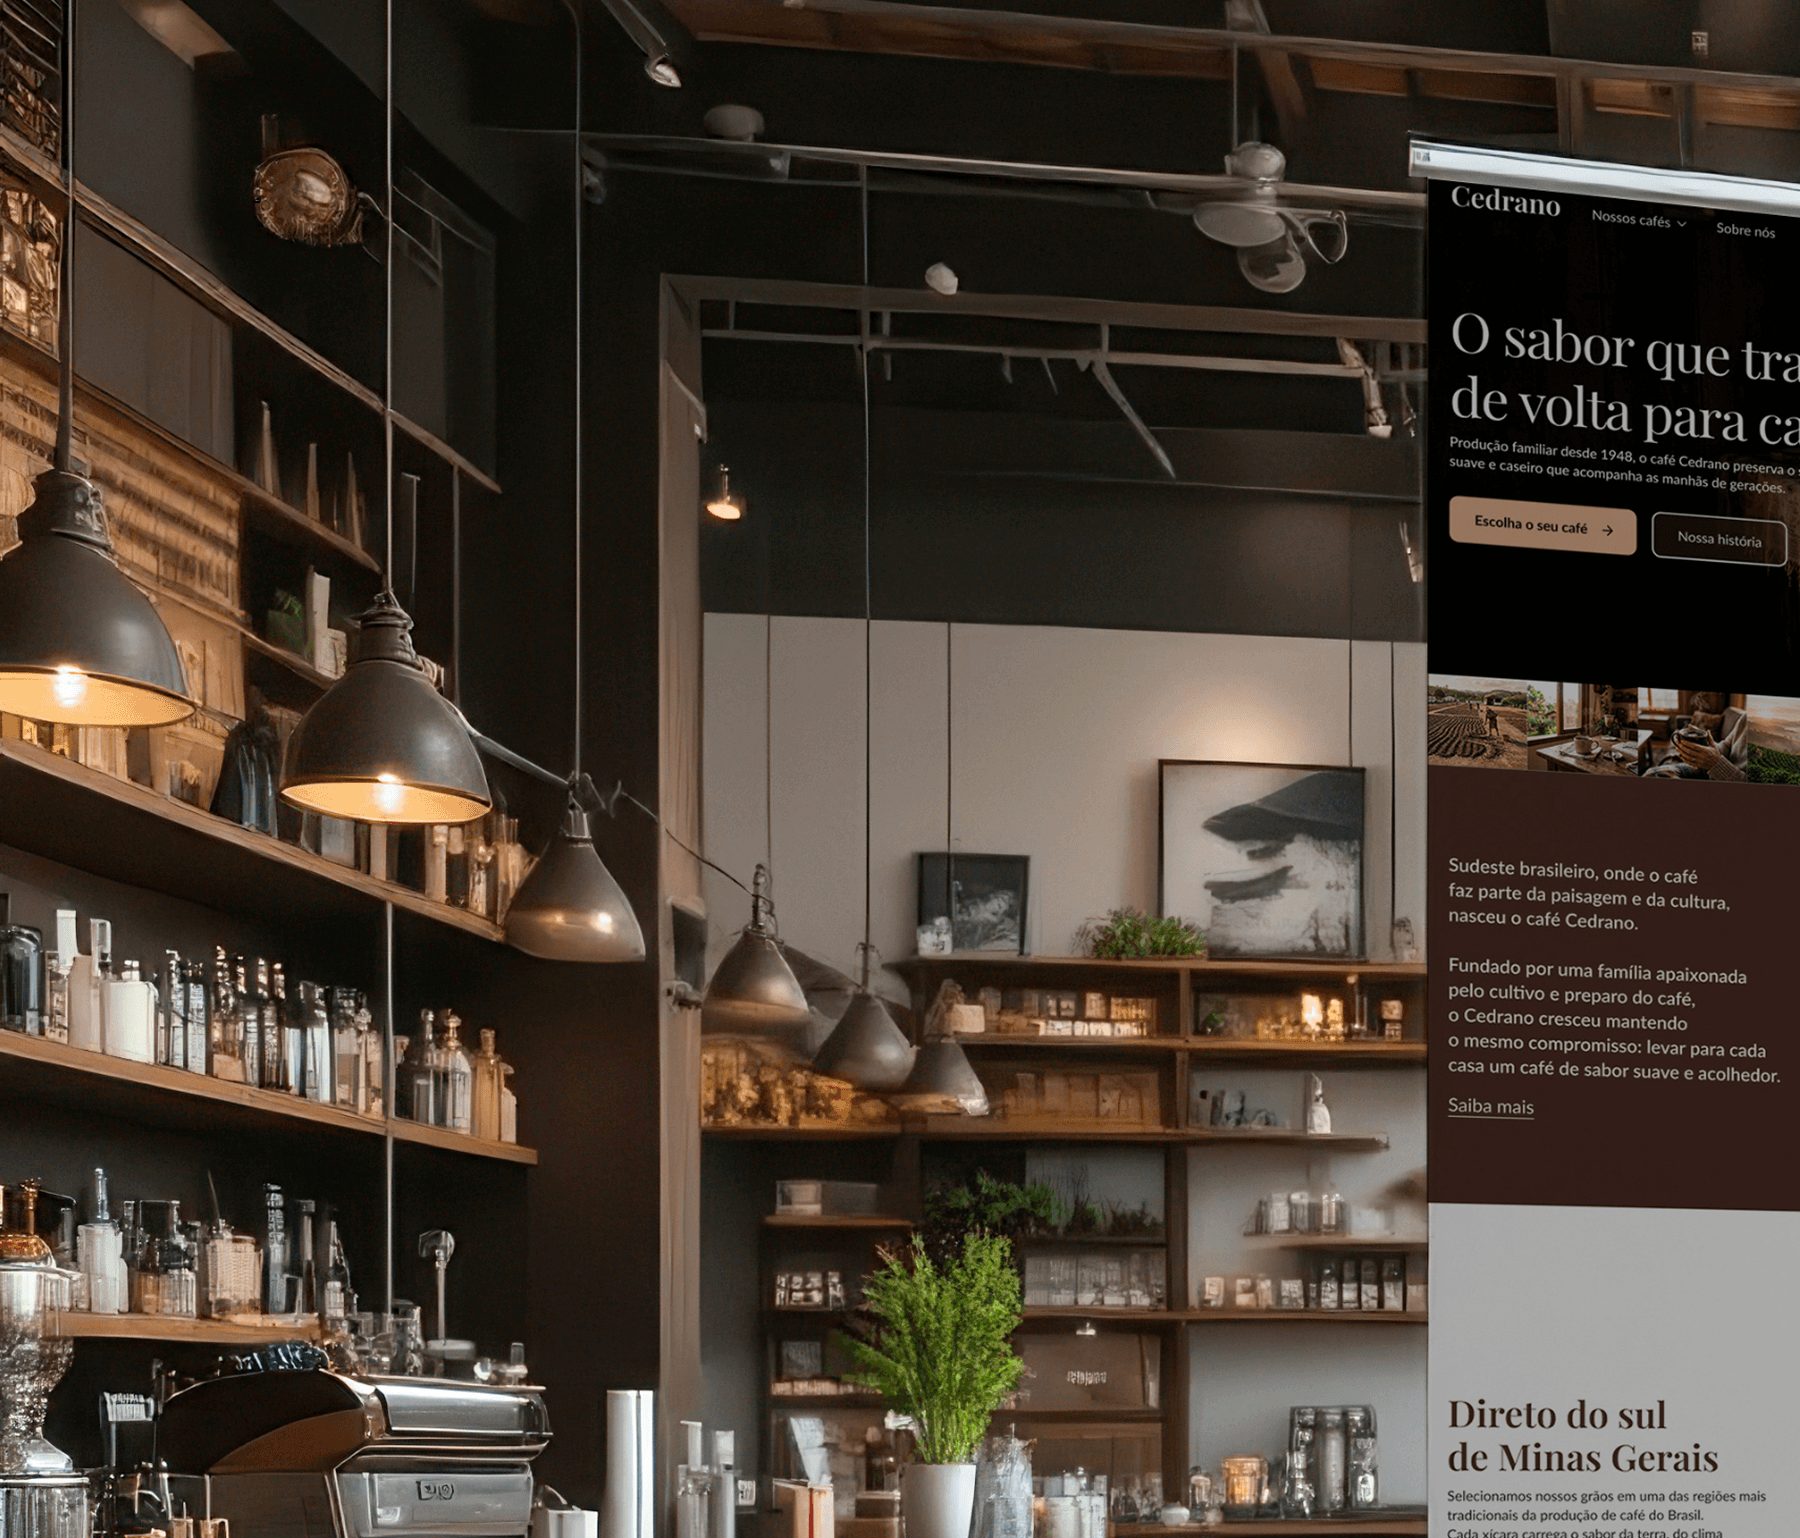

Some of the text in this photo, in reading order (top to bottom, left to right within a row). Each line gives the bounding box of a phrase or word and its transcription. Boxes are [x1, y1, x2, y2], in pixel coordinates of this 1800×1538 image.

[1451, 185, 1560, 217] Cedrano
[1592, 209, 1671, 228] Nossos cafés
[1716, 221, 1776, 239] Sobre nós
[1452, 312, 1489, 355] O
[1505, 318, 1635, 368] sabor
[1646, 340, 1730, 382] que
[1451, 374, 1507, 421] de
[1518, 384, 1632, 432] volta
[1643, 404, 1747, 444] para
[1449, 436, 1509, 453] Produção
[1512, 441, 1558, 456] familiar
[1560, 445, 1597, 459] desde
[1601, 448, 1636, 463] 1948,
[1638, 454, 1647, 464] o
[1650, 453, 1676, 466] café
[1678, 455, 1730, 471] Cedrano
[1733, 462, 1784, 475] preserva
[1786, 467, 1796, 476] o
[1474, 514, 1588, 535] Escolha o seu café
[1678, 530, 1762, 548] Nossa história
[1448, 857, 1698, 884] Sudeste brasileiro, onde o café
[1448, 882, 1730, 912] faz parte da paisagem e da cultura,
[1448, 911, 1638, 930] nasceu o café Cedrano.
[1449, 957, 1747, 984] Fundado por uma família apaixonada
[1448, 1007, 1688, 1031] o Cedrano cresceu mantendo
[1448, 1097, 1534, 1115] Saiba mais
[1448, 1398, 1666, 1430] Direto do sul
[1448, 1441, 1718, 1472] de Minas Gerais
[1447, 1489, 1767, 1504] Selecionamos nossos grãos em uma das regiões mais
